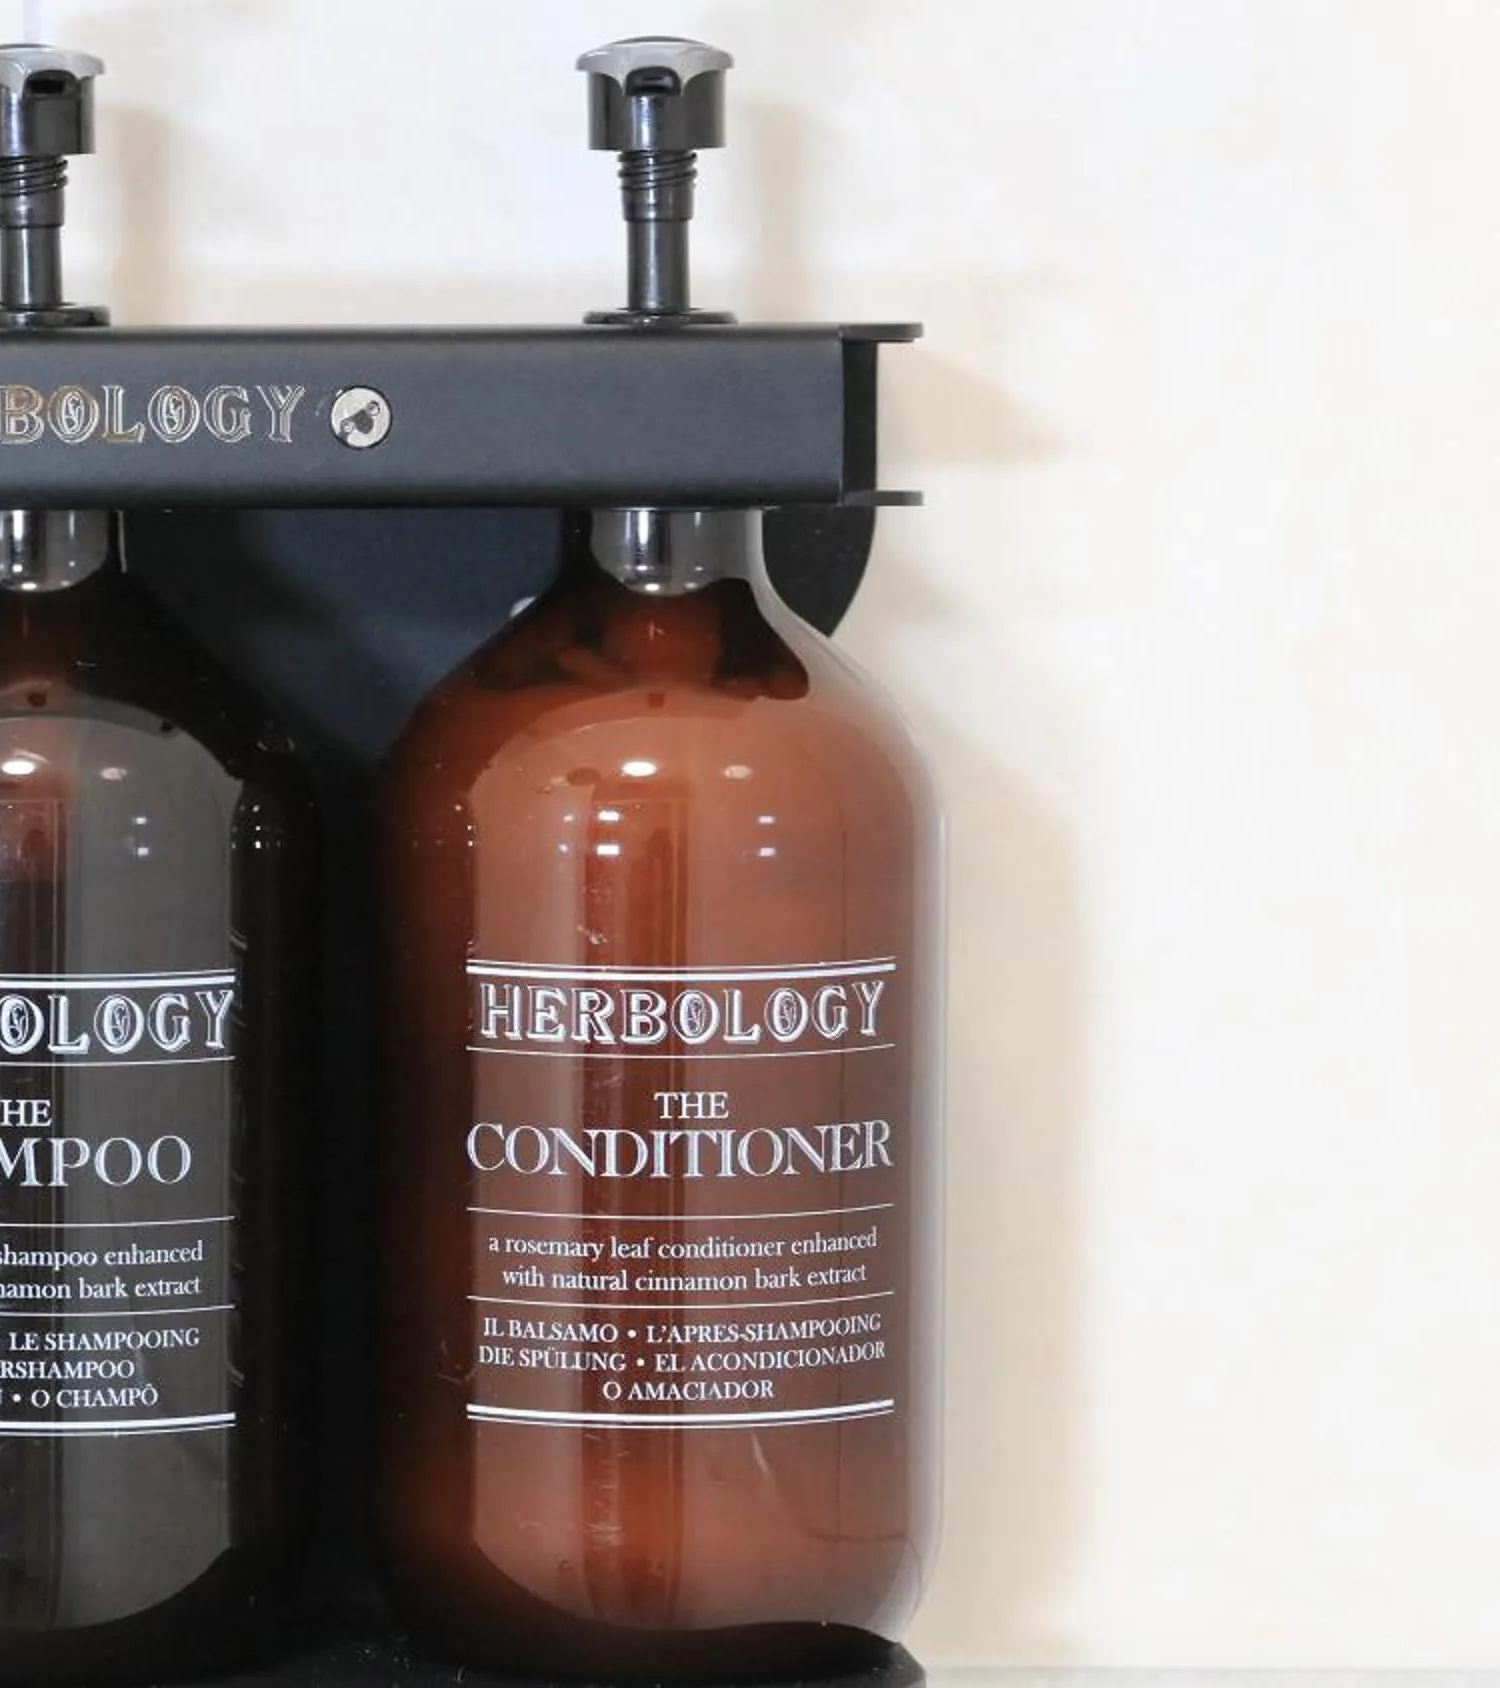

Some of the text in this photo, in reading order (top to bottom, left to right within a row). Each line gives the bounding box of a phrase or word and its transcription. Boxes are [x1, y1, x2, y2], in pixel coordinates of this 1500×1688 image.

[480, 980, 885, 1045] HERBOLOGY
[654, 1092, 729, 1118] THE
[466, 1120, 894, 1177] CONDITIONER
[104, 1240, 203, 1265] enhanced
[489, 1227, 877, 1262] a rosemary leaf conditioner enhanced
[79, 1277, 128, 1298] bark
[135, 1276, 200, 1297] extract
[503, 1263, 867, 1290] with natural cinnamon bark extract
[10, 1332, 39, 1351] LE
[46, 1327, 200, 1351] SHAMPOOING
[484, 1313, 881, 1344] IL BALSAMO L'APRES-SHAMPOOING
[478, 1341, 885, 1373] DIE SPÜLUNG EL ACONDICIONADOR
[31, 1389, 50, 1408] O
[603, 1380, 773, 1401] O AMACIADOR
